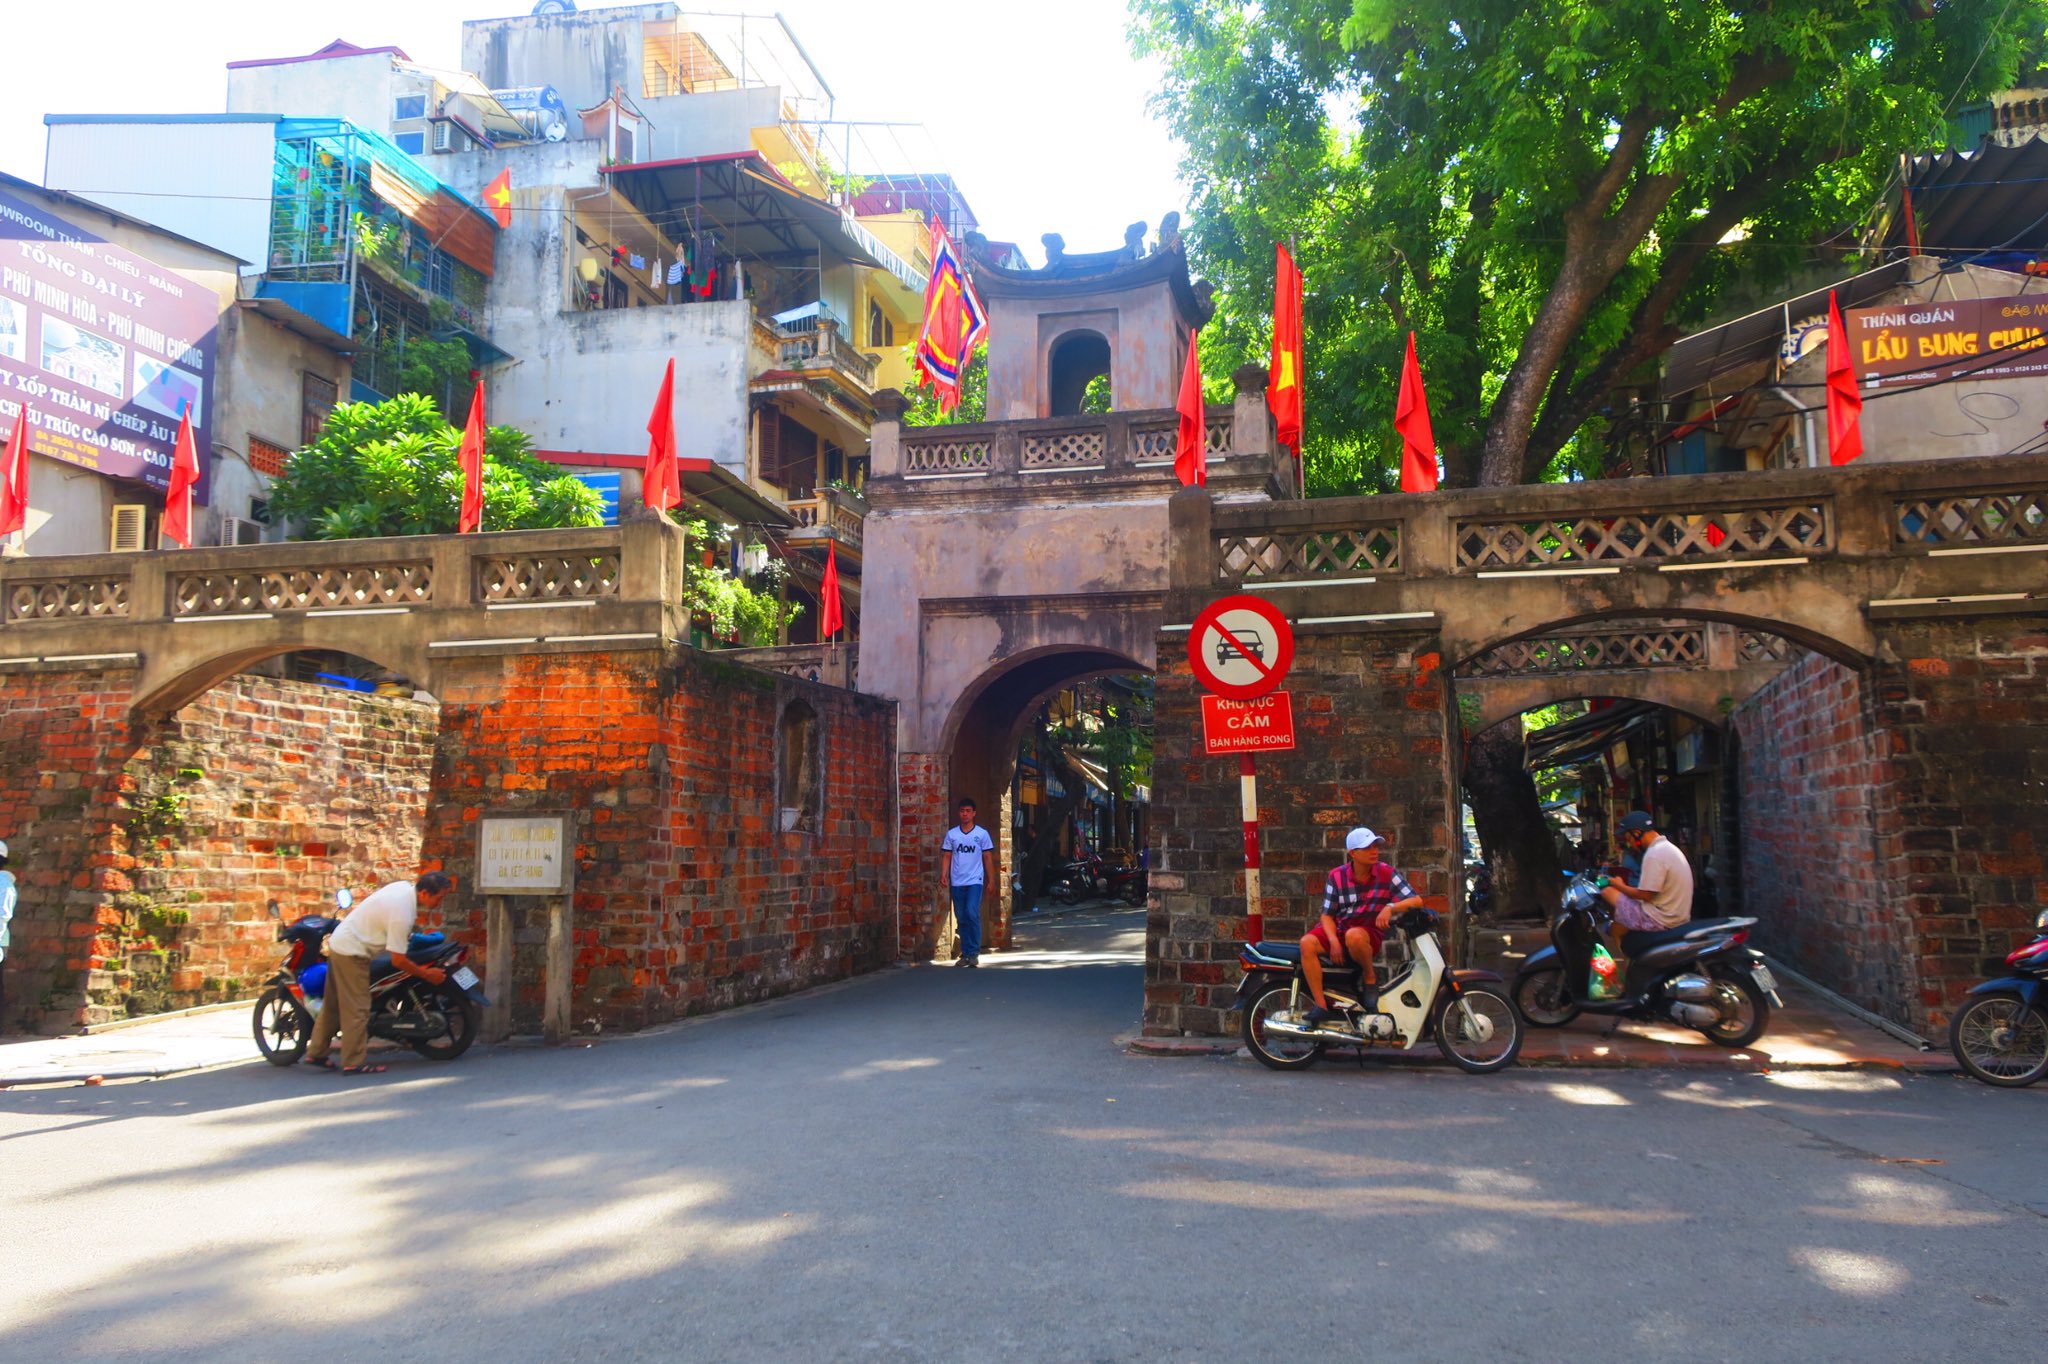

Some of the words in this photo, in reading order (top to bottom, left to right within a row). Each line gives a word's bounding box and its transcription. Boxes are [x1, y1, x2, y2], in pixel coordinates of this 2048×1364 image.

[18, 241, 76, 278] TỔNG
[80, 269, 118, 298] ĐẠI
[121, 288, 146, 309] LÝ
[104, 254, 140, 278] CHIẾU
[3, 266, 32, 298] PHÚ
[34, 279, 69, 314] MINH
[72, 295, 98, 327] HÒA
[108, 311, 133, 340] PHÚ
[134, 322, 165, 354] MINH
[167, 337, 203, 369] CƯỜNG
[1859, 312, 1907, 328] THÍNH
[1909, 308, 1955, 325] QUÁN
[1919, 332, 1979, 357] BUNG
[15, 374, 48, 398] XỐP
[49, 390, 91, 418] THẢM
[112, 411, 148, 433] GHÉP
[149, 424, 169, 441] ÂU
[44, 413, 81, 438] TRÚC
[110, 436, 136, 457] SƠN
[143, 450, 168, 467] CAO
[1216, 699, 1245, 710] KHU
[1248, 696, 1275, 710] VỰC
[1227, 711, 1270, 729] CẤM
[1210, 738, 1231, 747] BÁN
[1233, 735, 1260, 746] HÀNG
[1263, 734, 1291, 745] RONG
